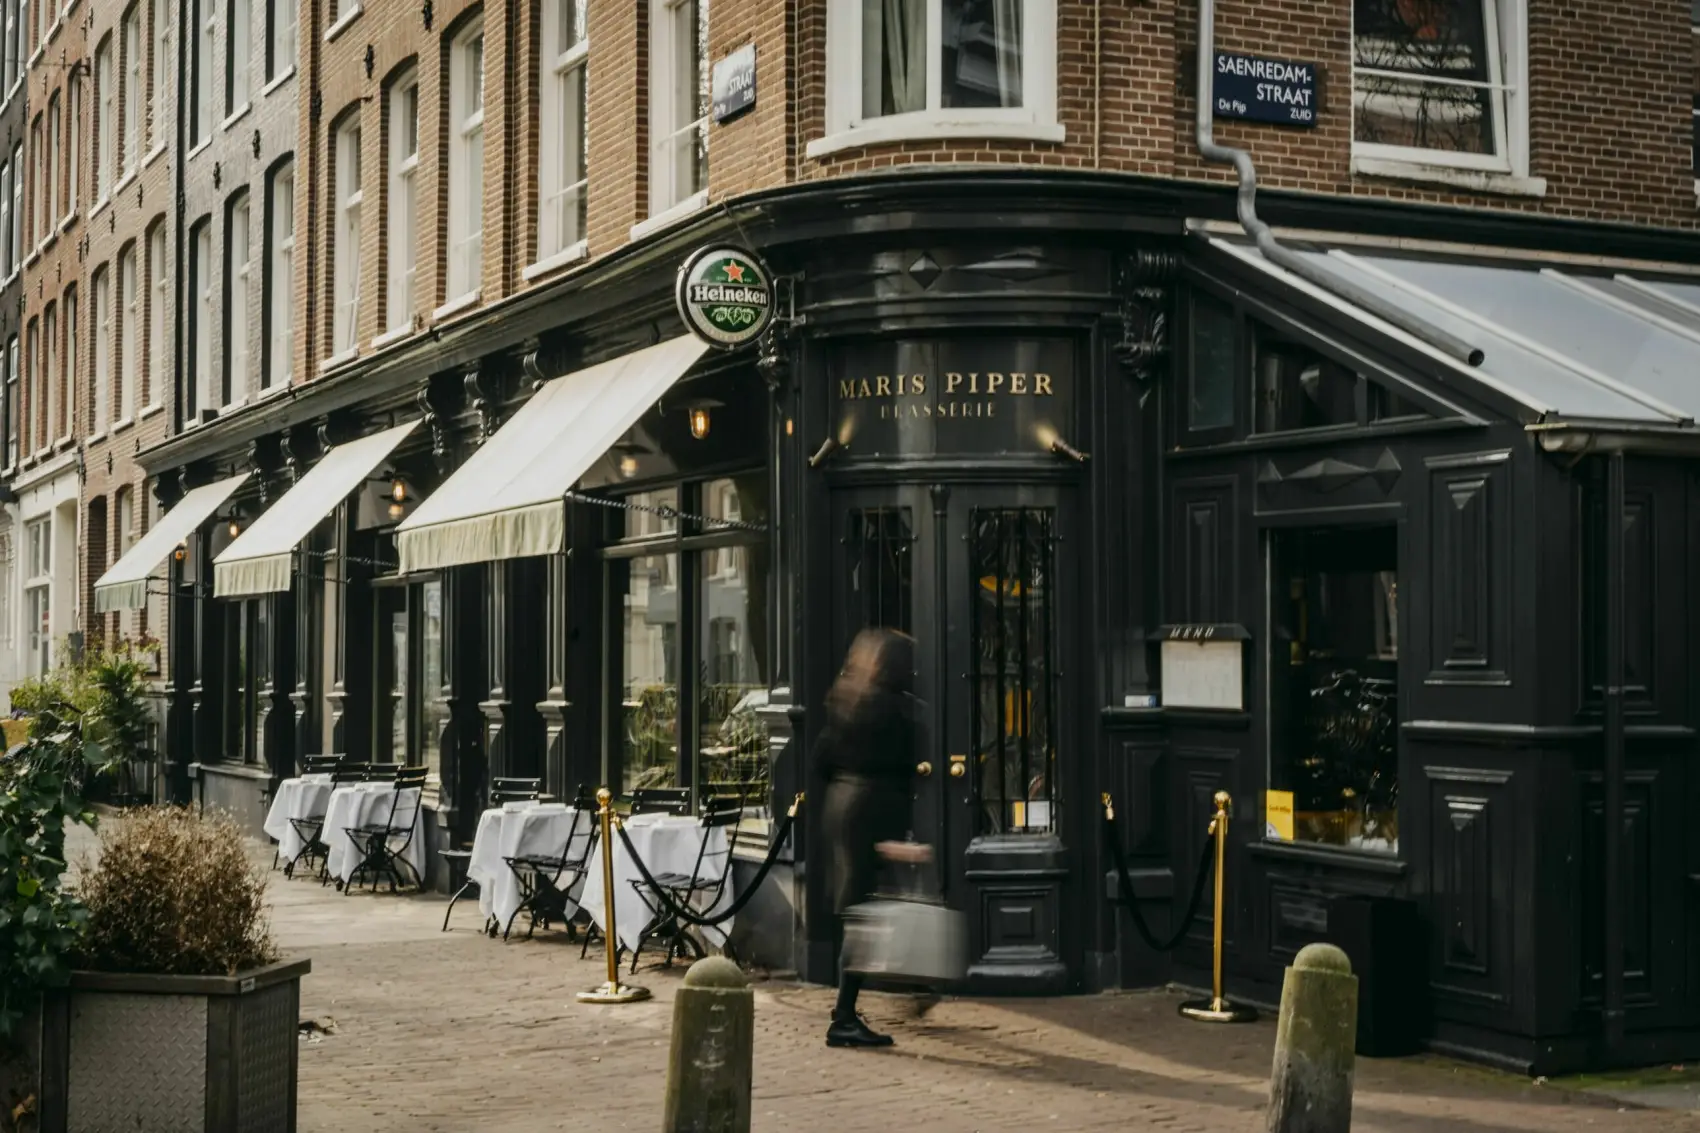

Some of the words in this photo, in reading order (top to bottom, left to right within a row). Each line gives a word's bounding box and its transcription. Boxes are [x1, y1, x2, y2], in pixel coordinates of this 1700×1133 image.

[1217, 55, 1312, 84] SAENREDAM-
[1218, 98, 1231, 111] De
[1256, 83, 1312, 106] STRAAT
[1290, 107, 1312, 121] ZUID
[693, 285, 767, 304] Heineken
[840, 374, 925, 398] MARIS
[945, 372, 1053, 395] PIPER
